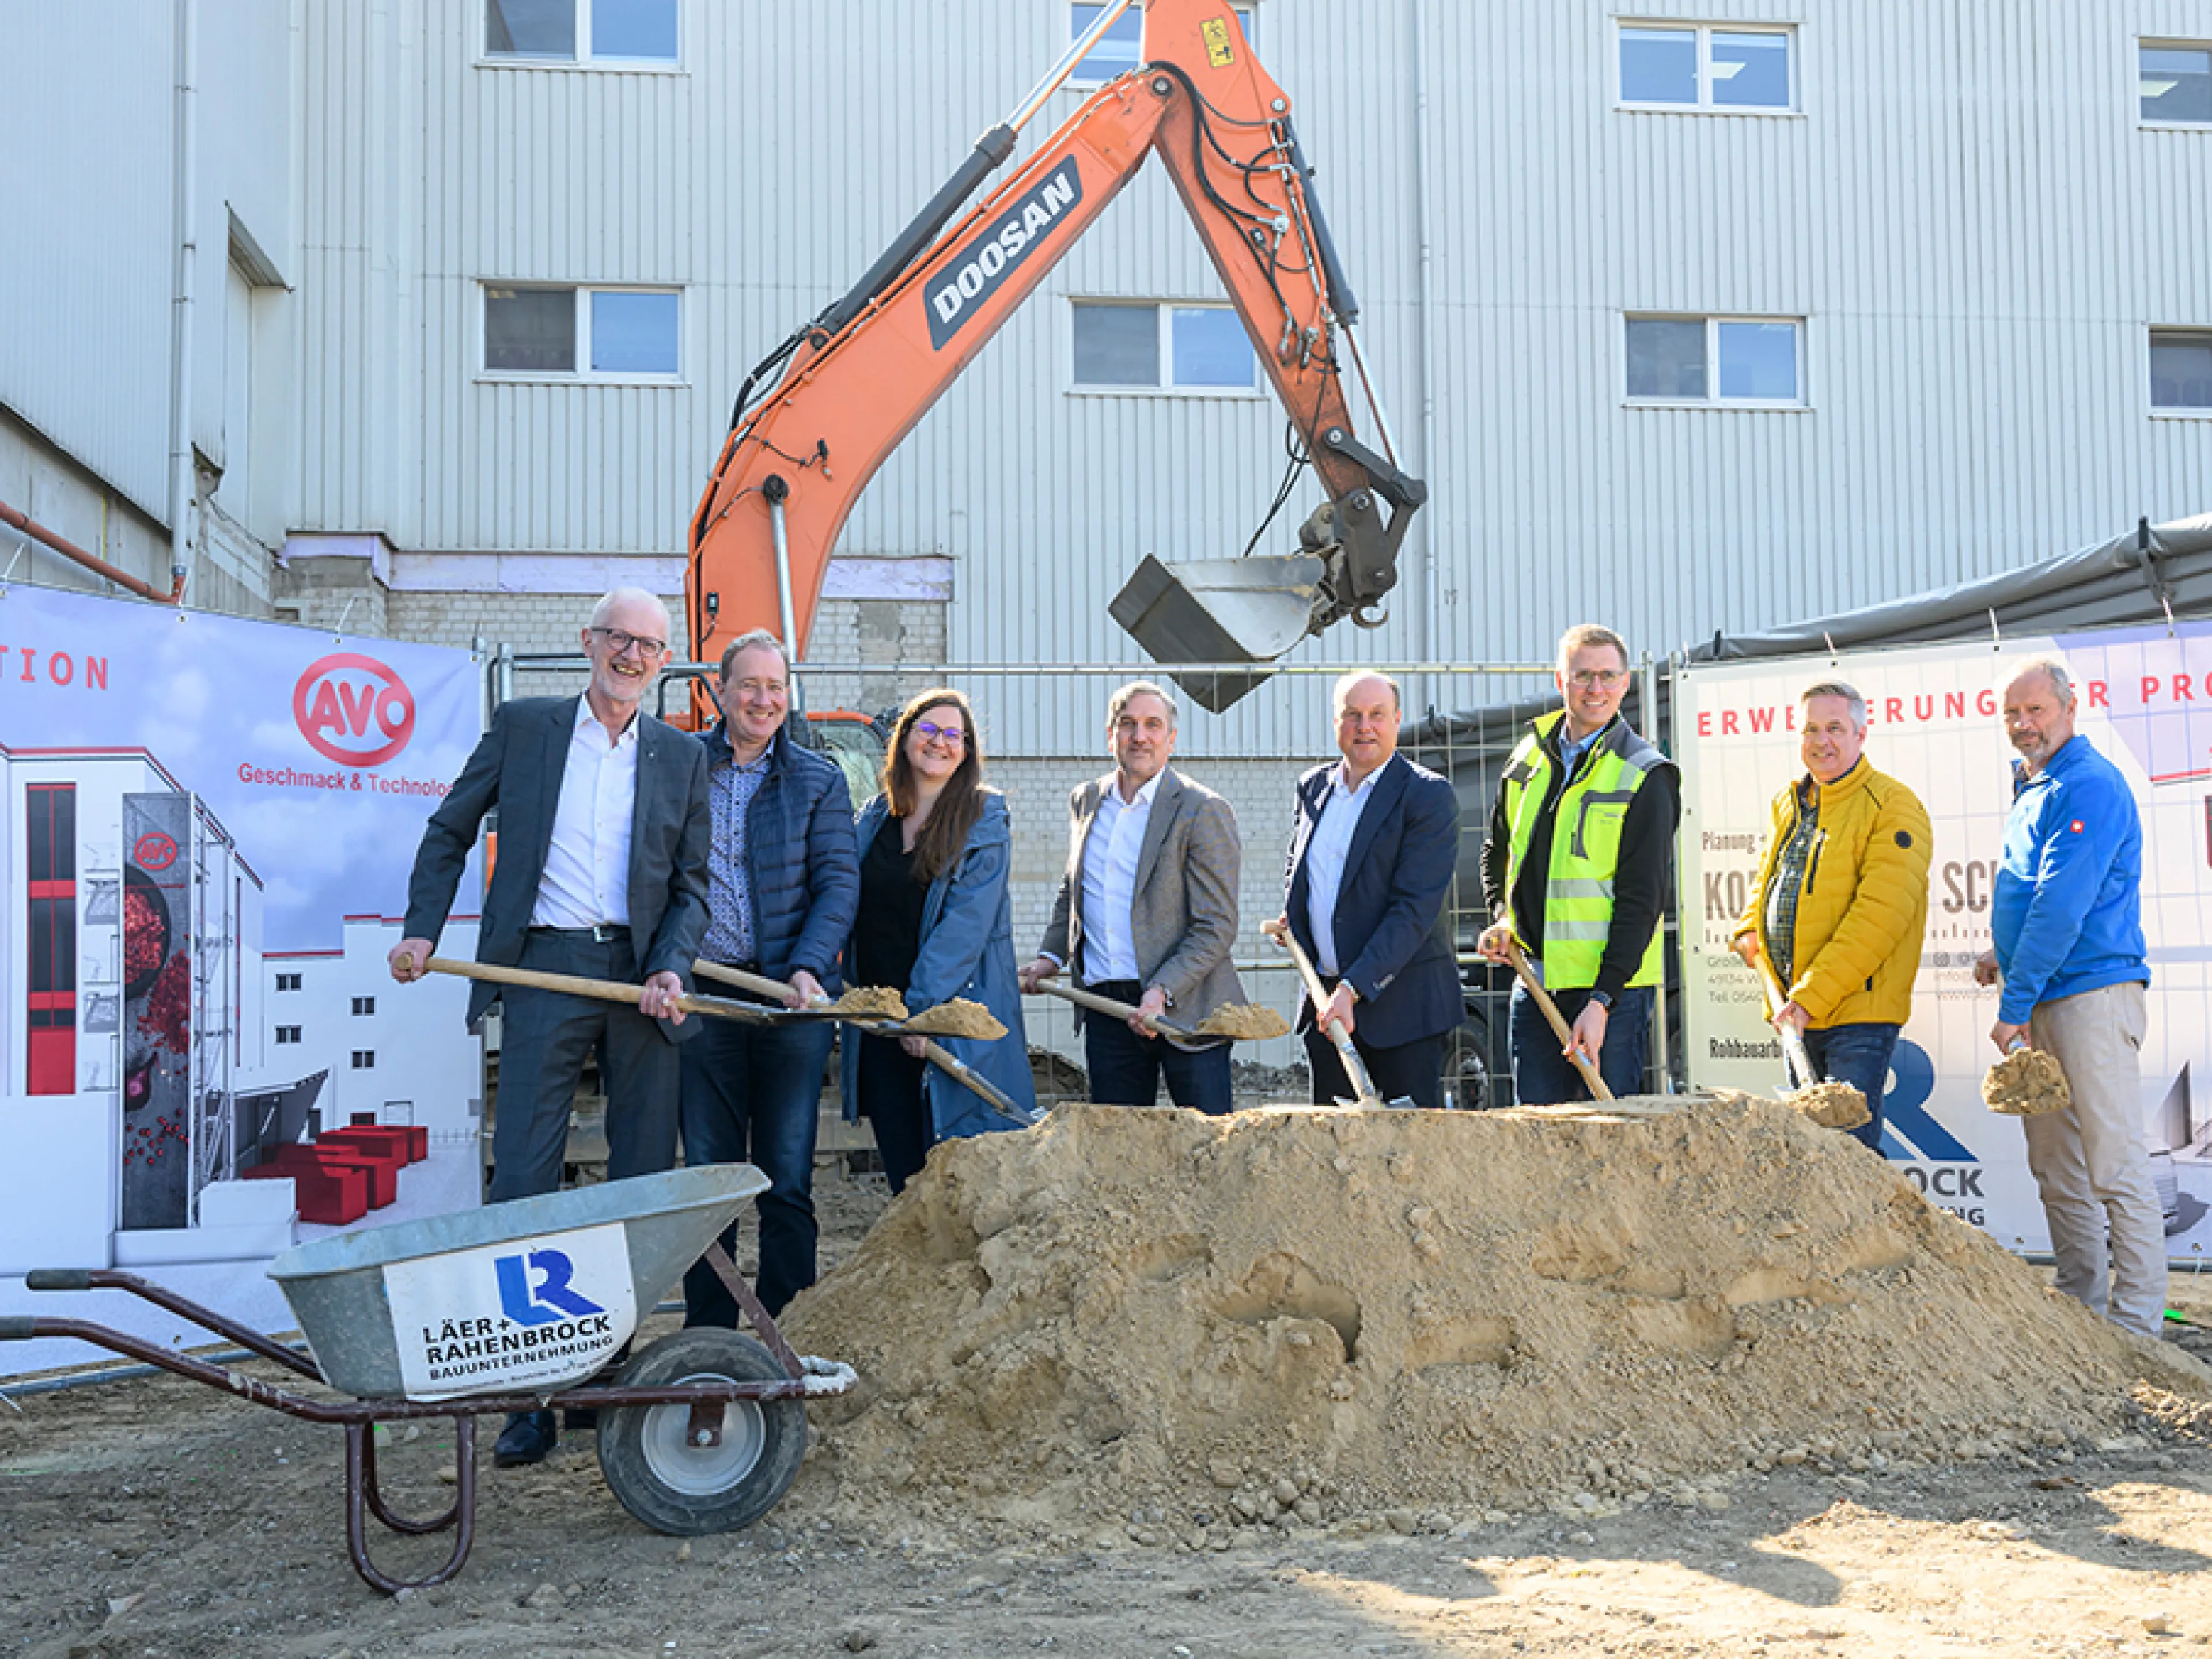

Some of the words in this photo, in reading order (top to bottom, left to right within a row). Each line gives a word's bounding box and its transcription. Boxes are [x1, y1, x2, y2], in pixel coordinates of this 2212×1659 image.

[933, 173, 1074, 323] DOOSAN
[305, 677, 414, 743] AVO
[1698, 690, 1997, 737] ERWERUNG
[237, 763, 345, 790] Geschmack
[350, 772, 362, 791] &
[1703, 831, 1755, 854] Planung
[1704, 870, 1757, 920] KO
[423, 1318, 493, 1343] LÄER
[425, 1315, 612, 1363] RAHENBROCK
[429, 1335, 612, 1380] BAUUNTERNEHMUNG
